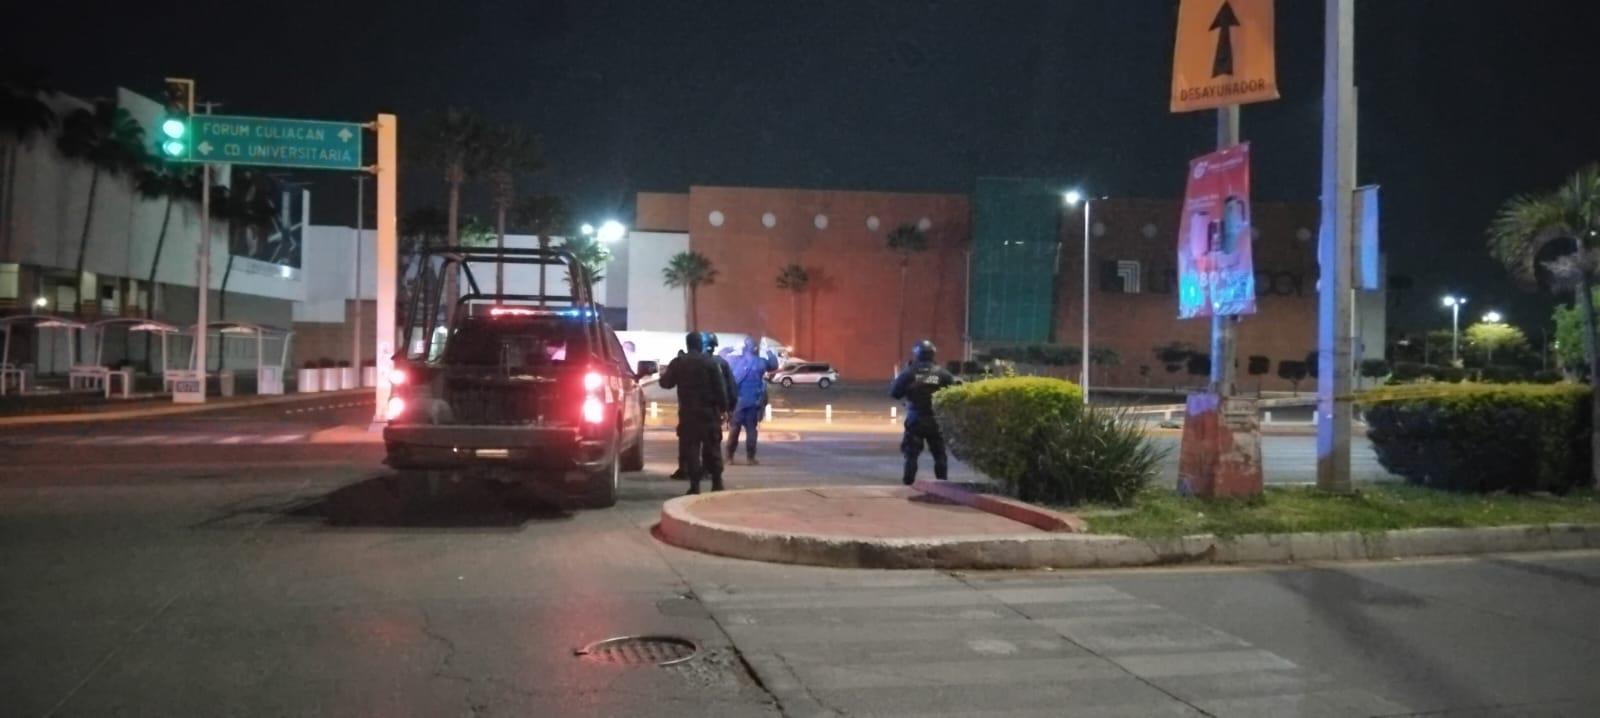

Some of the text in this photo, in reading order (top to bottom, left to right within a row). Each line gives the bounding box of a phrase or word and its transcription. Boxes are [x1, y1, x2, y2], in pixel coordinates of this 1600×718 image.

[1180, 78, 1265, 101] DESAYUNADOR
[202, 121, 325, 141] FORUM CULIACAN
[248, 143, 352, 162] UNIVERSITARIA
